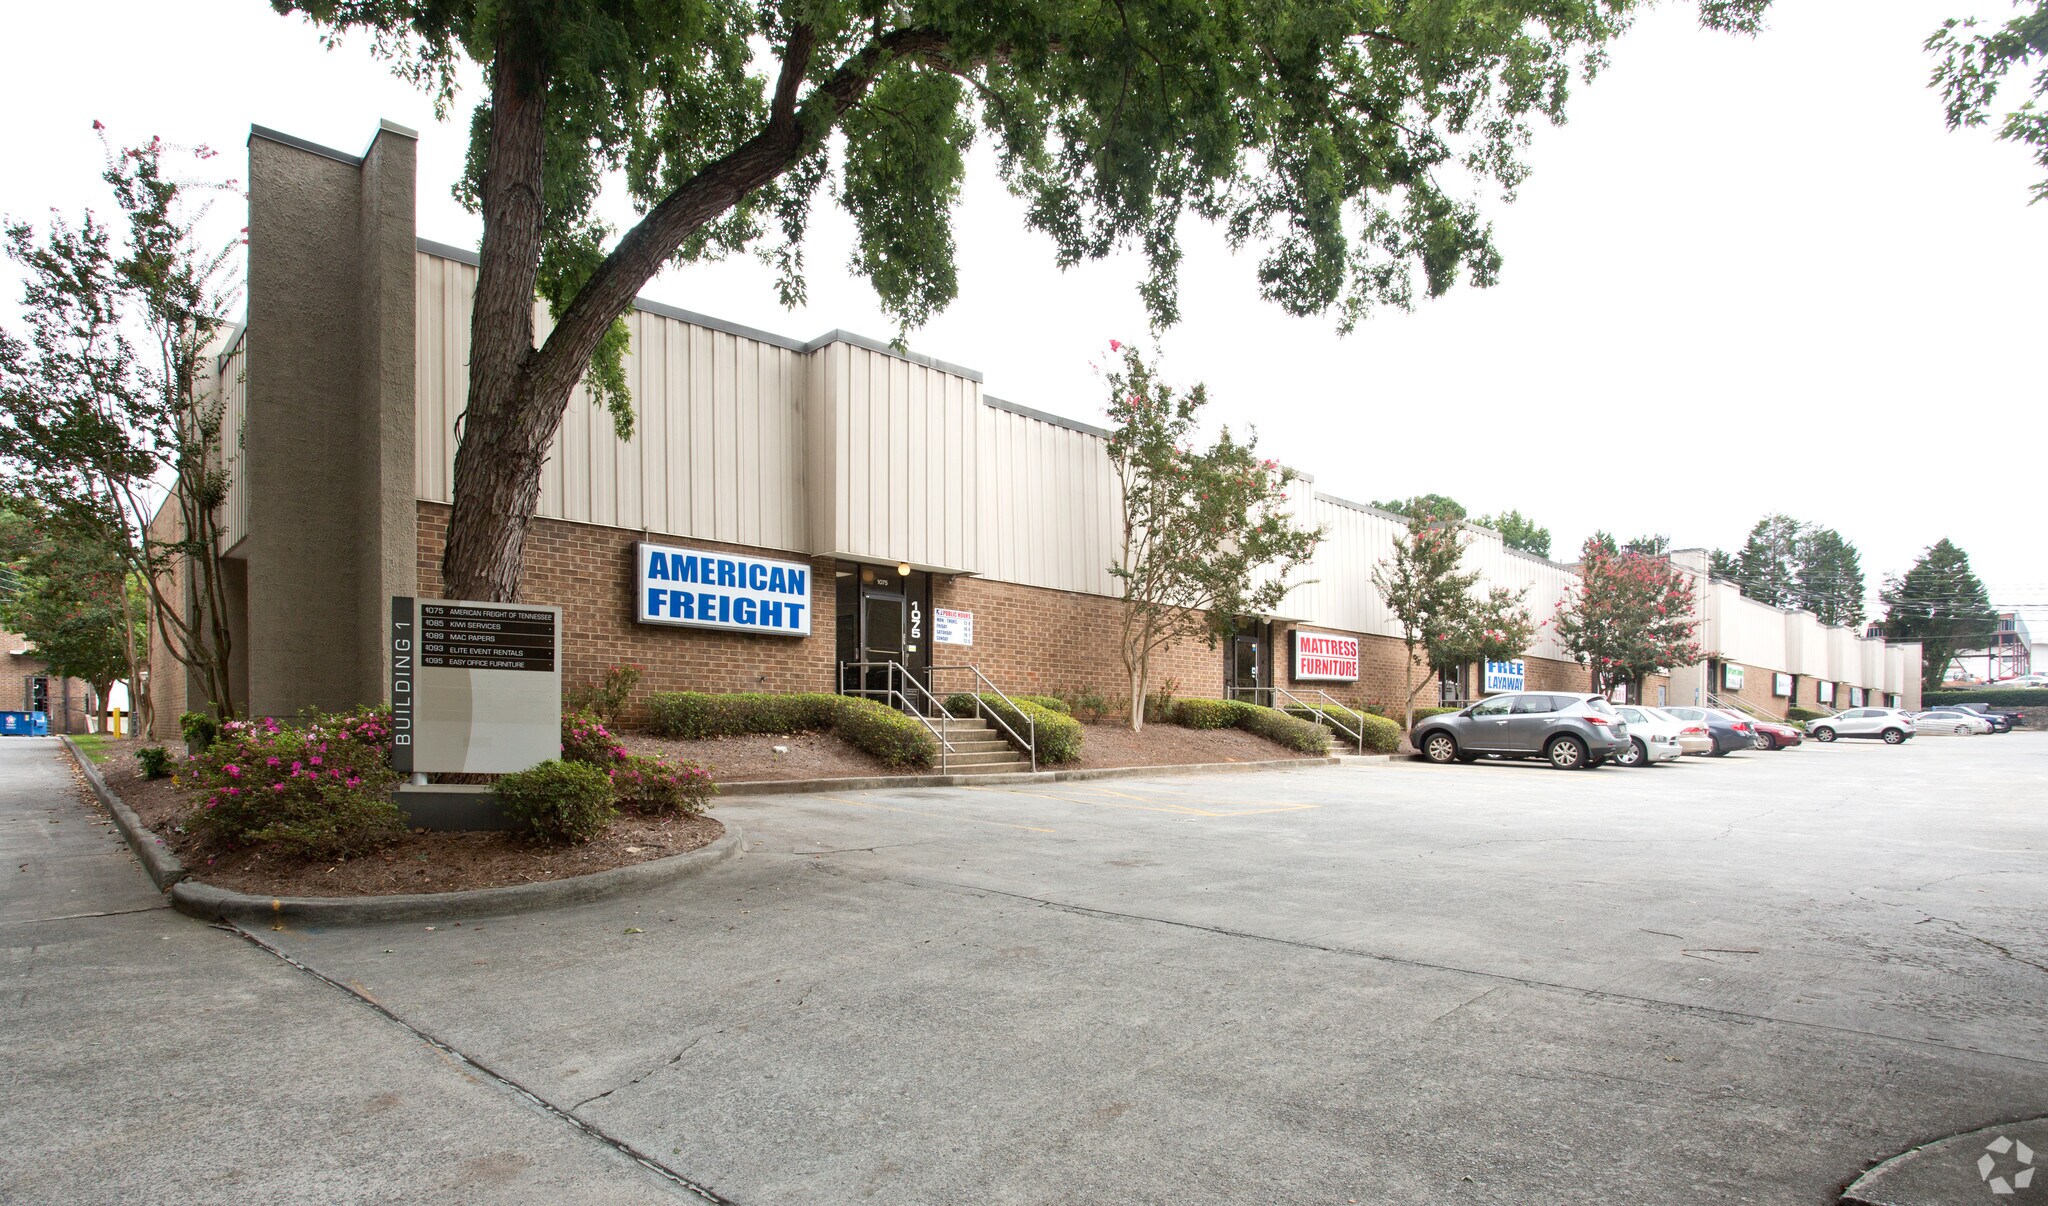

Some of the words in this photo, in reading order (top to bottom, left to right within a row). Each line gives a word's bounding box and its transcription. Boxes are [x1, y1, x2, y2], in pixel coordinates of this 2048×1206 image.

[648, 552, 804, 596] AMERICAN
[518, 612, 552, 620] TENNESSEE
[648, 588, 804, 628] FREIGHT
[468, 622, 501, 630] SERVICES
[911, 601, 920, 638] 1075
[1300, 637, 1356, 657] MATTRESS
[1300, 658, 1356, 676] FURNITURE
[1488, 660, 1524, 676] FREE
[395, 639, 410, 745] BUILDING
[1488, 676, 1524, 690] LAYAWAY
